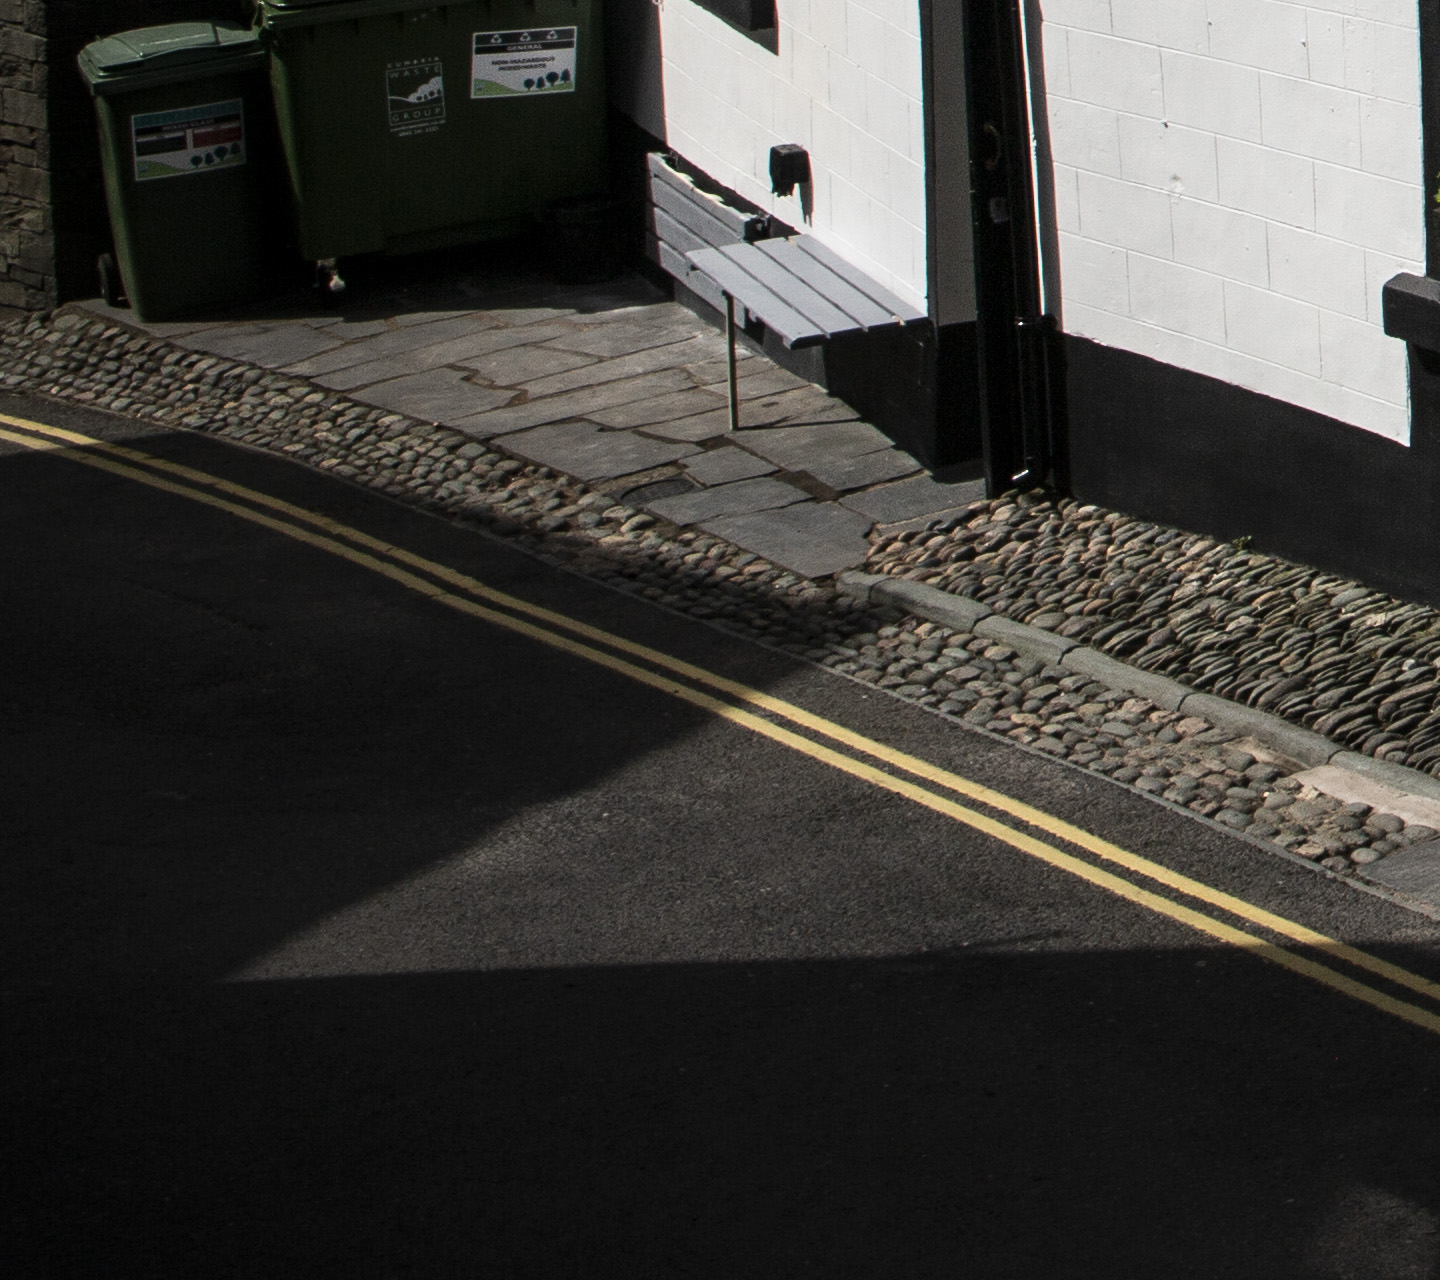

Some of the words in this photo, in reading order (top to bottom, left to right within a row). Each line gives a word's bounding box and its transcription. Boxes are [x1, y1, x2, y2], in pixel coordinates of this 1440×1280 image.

[507, 43, 543, 51] GENERAL
[387, 56, 440, 68] CUMBRIA
[389, 66, 442, 79] WASTE
[392, 107, 441, 122] GROUP
